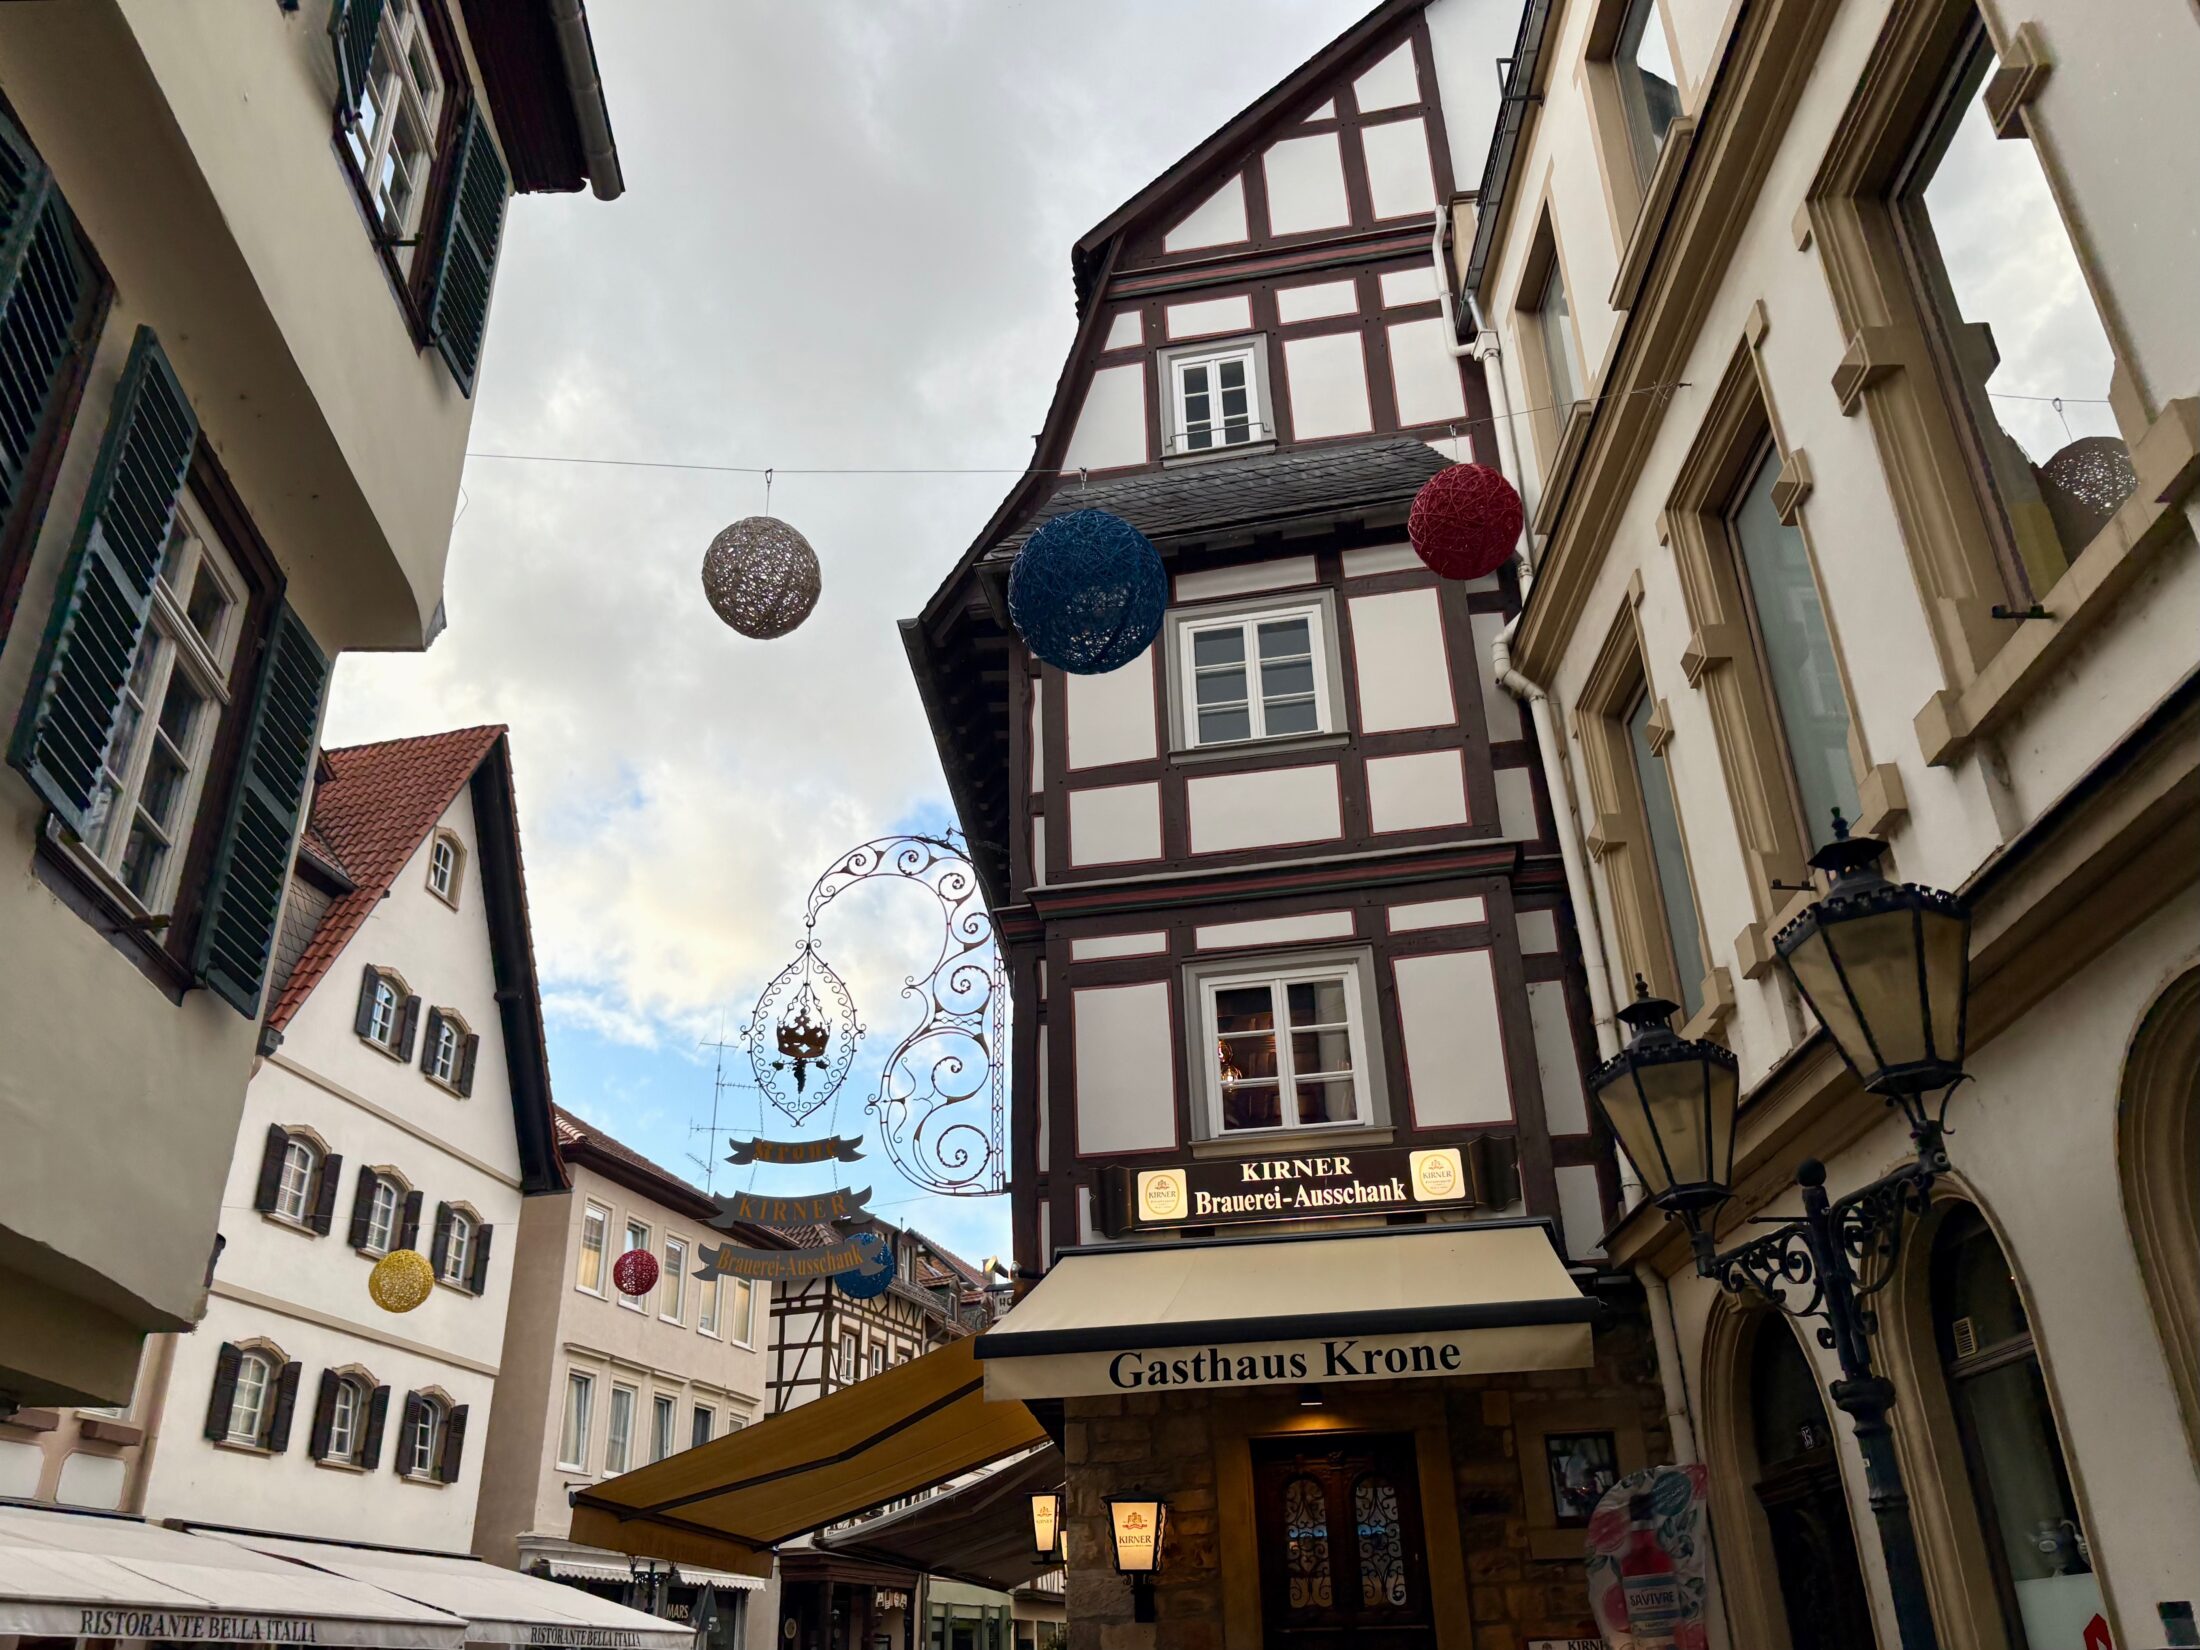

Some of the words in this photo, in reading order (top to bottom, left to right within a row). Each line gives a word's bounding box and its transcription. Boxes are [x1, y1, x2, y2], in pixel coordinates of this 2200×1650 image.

[1240, 1156, 1353, 1182] KIRNER
[1423, 1170, 1452, 1179] KIRNER
[1148, 1190, 1177, 1199] KIRNER
[1194, 1177, 1407, 1216] Brauerei-Ausschank
[739, 1195, 848, 1221] KIRNER
[718, 1246, 862, 1276] Brauerei-Ausschank
[1109, 1348, 1308, 1389] Gasthaus
[1320, 1340, 1462, 1377] Krone
[1118, 1535, 1152, 1543] KIRNER
[1629, 1591, 1674, 1607] SAVIVRE
[666, 1604, 689, 1619] MARS
[79, 1609, 205, 1638] RISTORANTE
[208, 1616, 262, 1641] BELLA
[265, 1618, 317, 1643] ITALIA
[530, 1626, 587, 1646] RISTORANTE
[588, 1629, 613, 1647] BELLA
[614, 1631, 641, 1648] ITALIA
